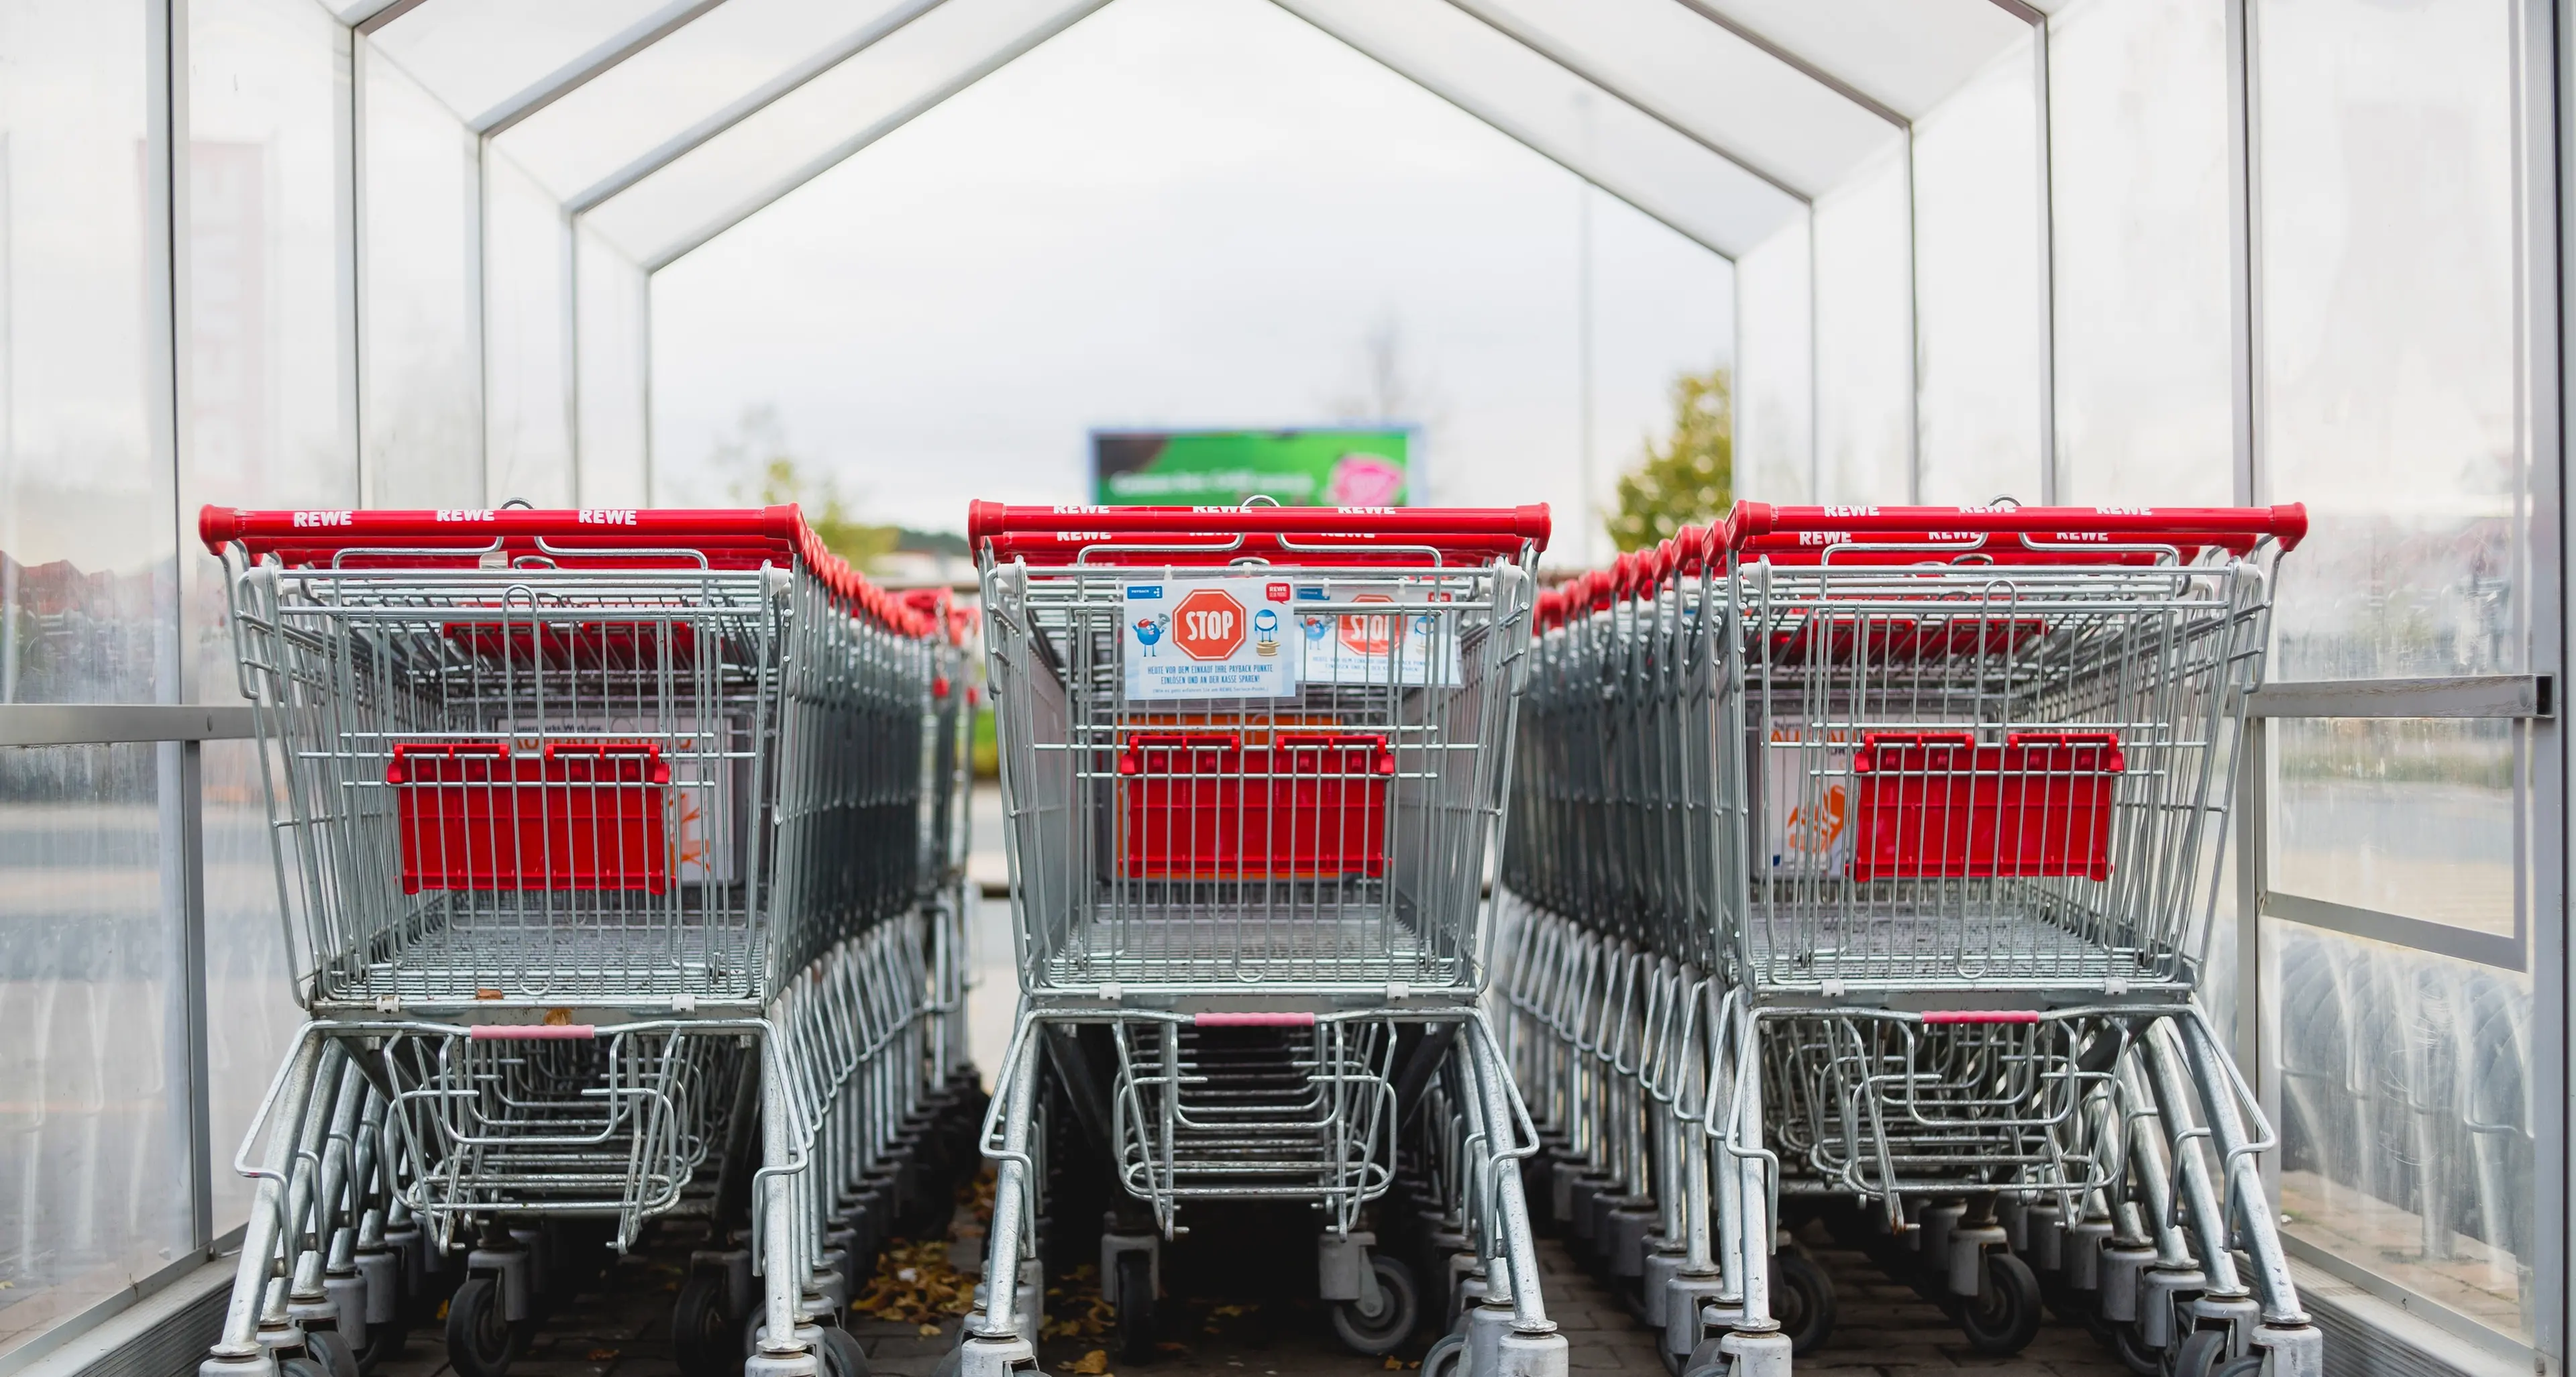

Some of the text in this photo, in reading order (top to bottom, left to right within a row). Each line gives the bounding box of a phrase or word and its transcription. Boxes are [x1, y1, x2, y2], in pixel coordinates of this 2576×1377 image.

[1823, 506, 1880, 517] REWE
[293, 509, 637, 527] REWE REWE REWE
[1799, 531, 1852, 545] REWE
[1185, 610, 1234, 641] STOP
[1148, 664, 1273, 675] HEUTE VOR DEM EINKAUF IHRE PAYBACK PUNKTE
[1187, 675, 1198, 684] UND
[1200, 675, 1208, 683] AN
[1209, 675, 1220, 683] DER
[1222, 675, 1237, 683] KASSE
[1239, 674, 1260, 683] SPAREN!
